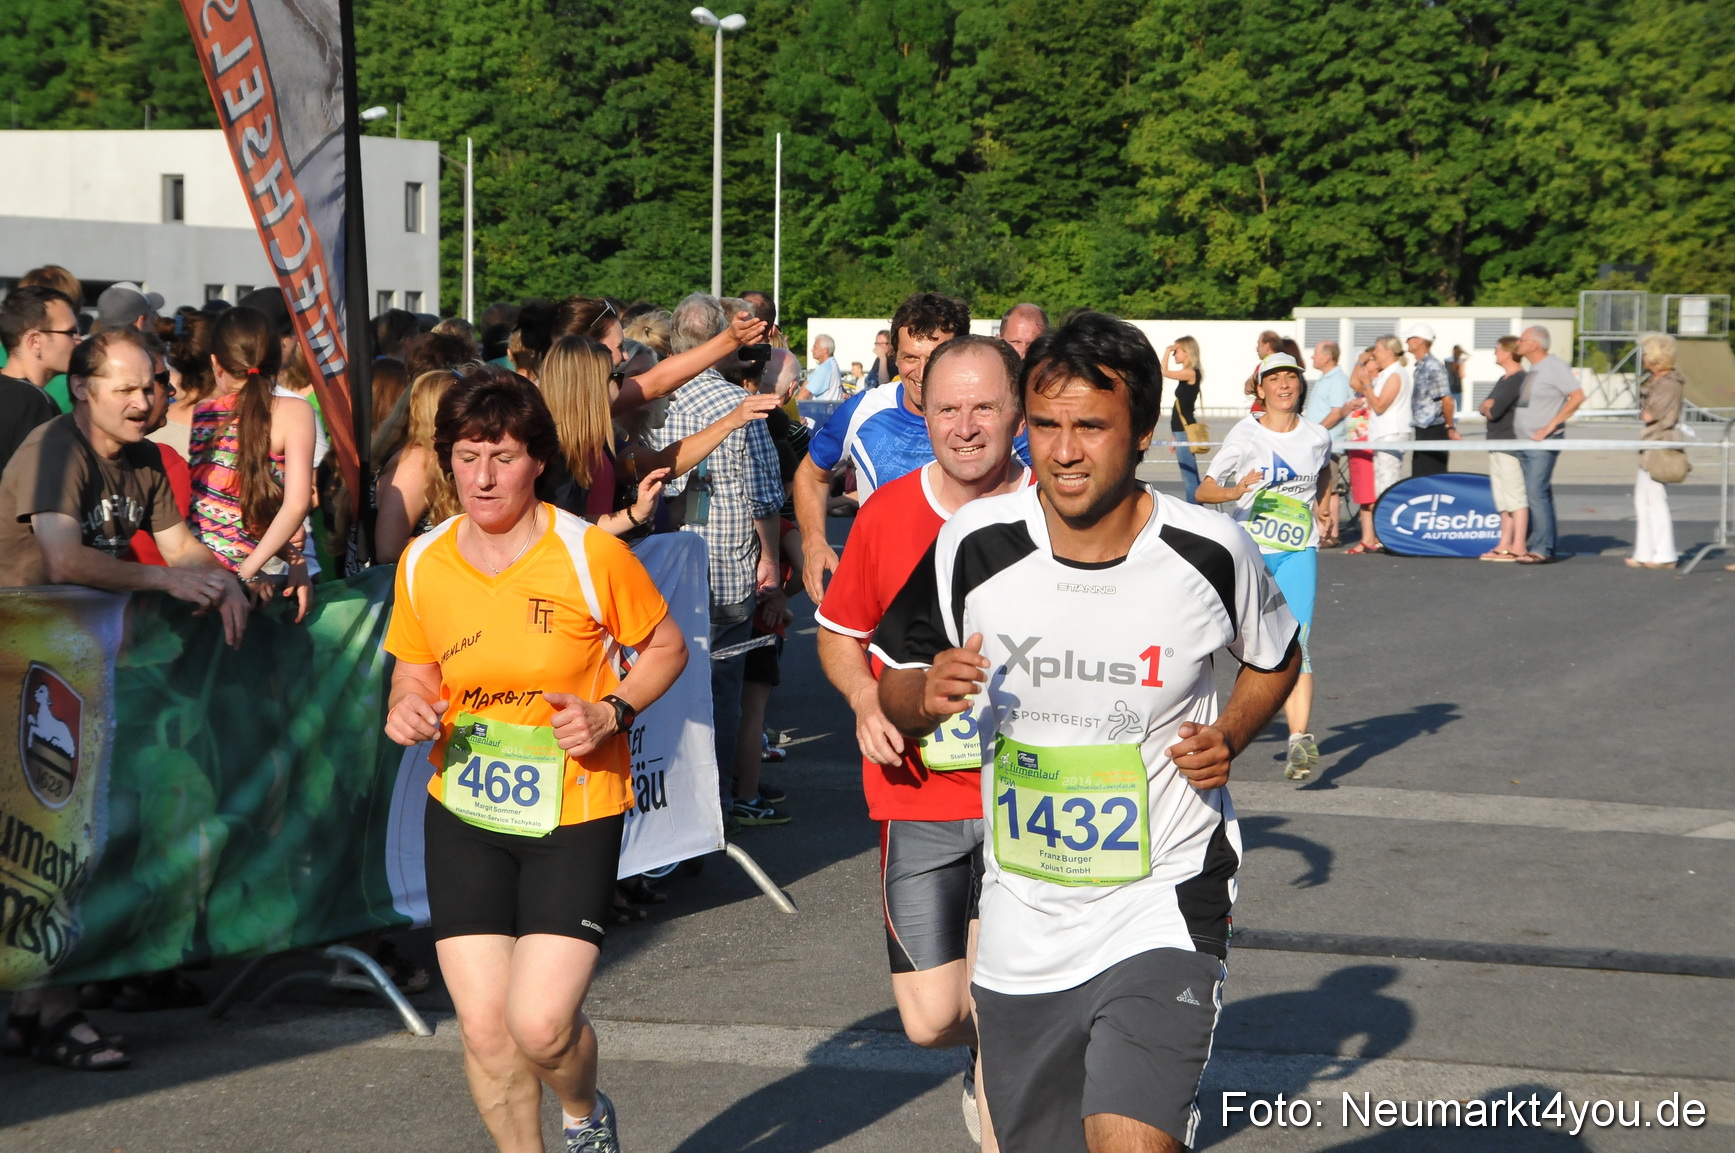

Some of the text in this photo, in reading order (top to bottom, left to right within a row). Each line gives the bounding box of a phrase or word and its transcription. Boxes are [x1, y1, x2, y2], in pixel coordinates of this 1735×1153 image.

[1250, 515, 1304, 546] 5069
[1057, 582, 1117, 595] STANNO
[462, 687, 543, 709] MARGIT
[1012, 710, 1102, 729] SPORTGEIST
[1009, 763, 1061, 780] firmenlauf
[458, 756, 540, 807] 468
[1062, 776, 1093, 786] 2014
[474, 801, 522, 815] Margit Sommer
[998, 788, 1140, 851] 1432
[1039, 850, 1093, 864] Franz Burger
[1040, 861, 1064, 873] Xplus1
[1065, 866, 1091, 874] GmbH
